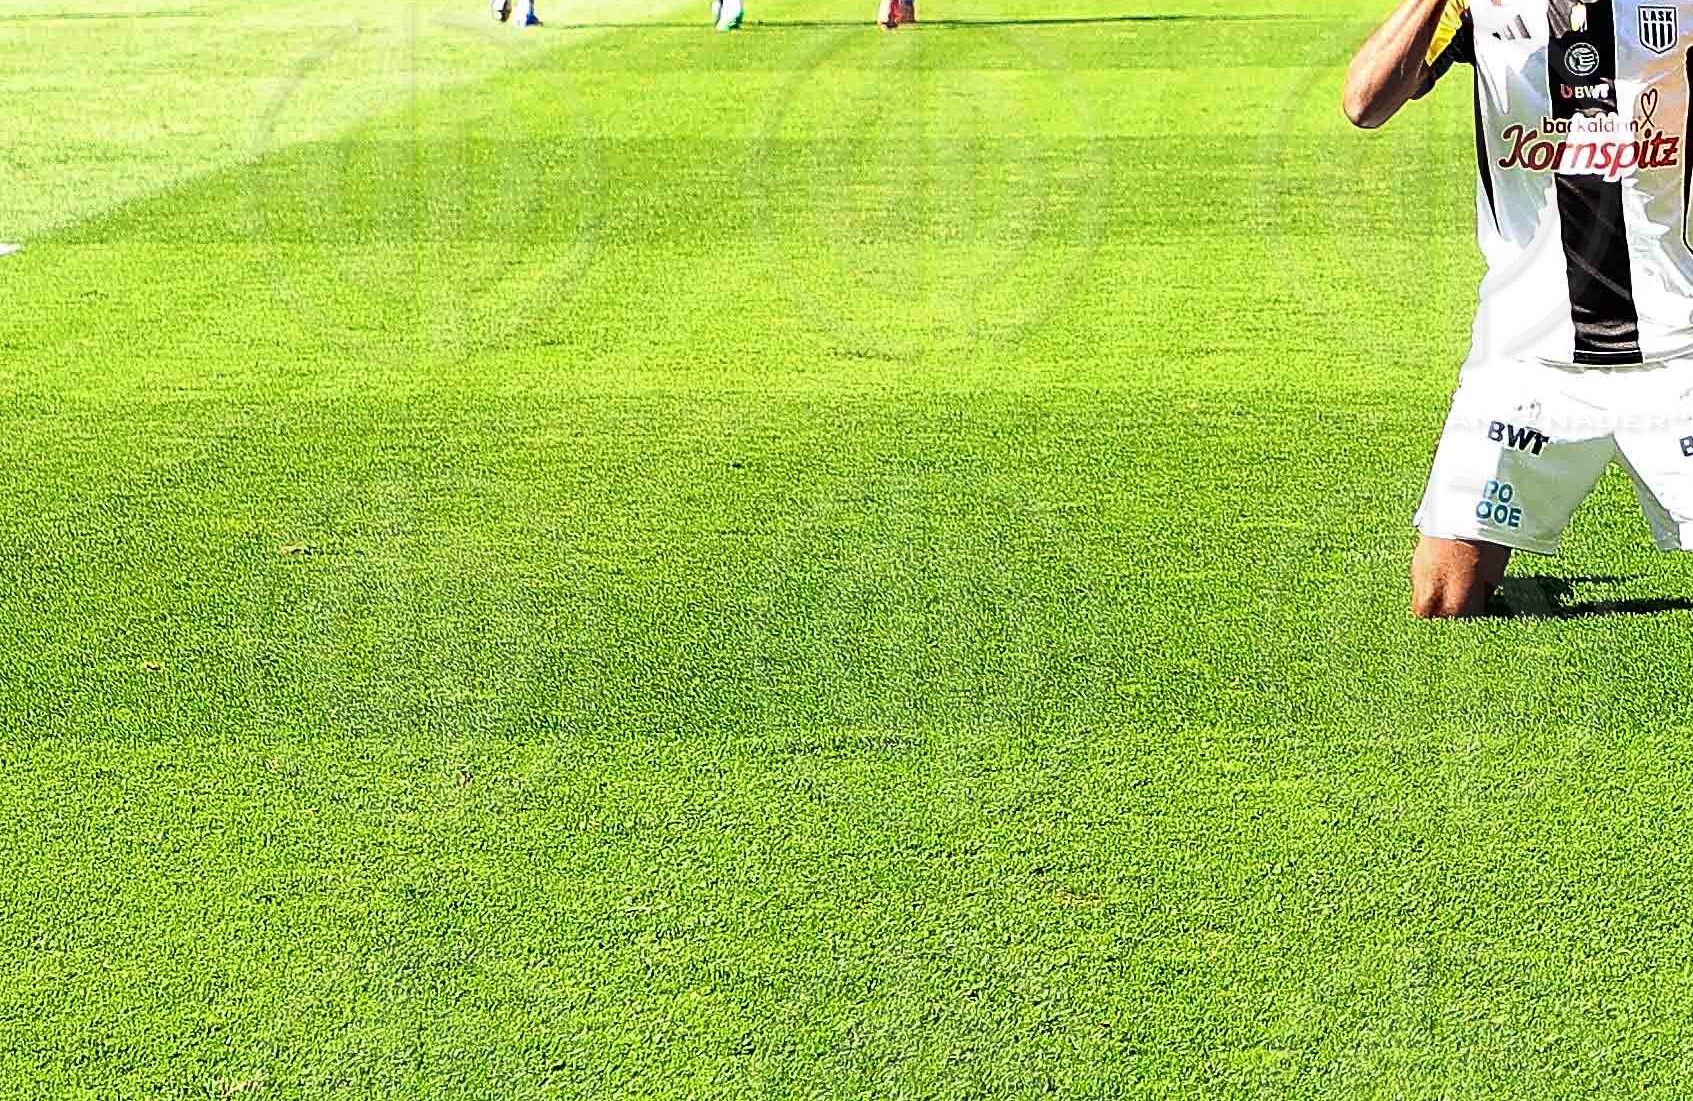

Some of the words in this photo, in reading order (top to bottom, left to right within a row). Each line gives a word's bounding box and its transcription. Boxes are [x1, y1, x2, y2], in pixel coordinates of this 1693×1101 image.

[1642, 10, 1673, 22] LASK
[1498, 124, 1680, 178] Kornspitz
[1487, 419, 1551, 456] BWT
